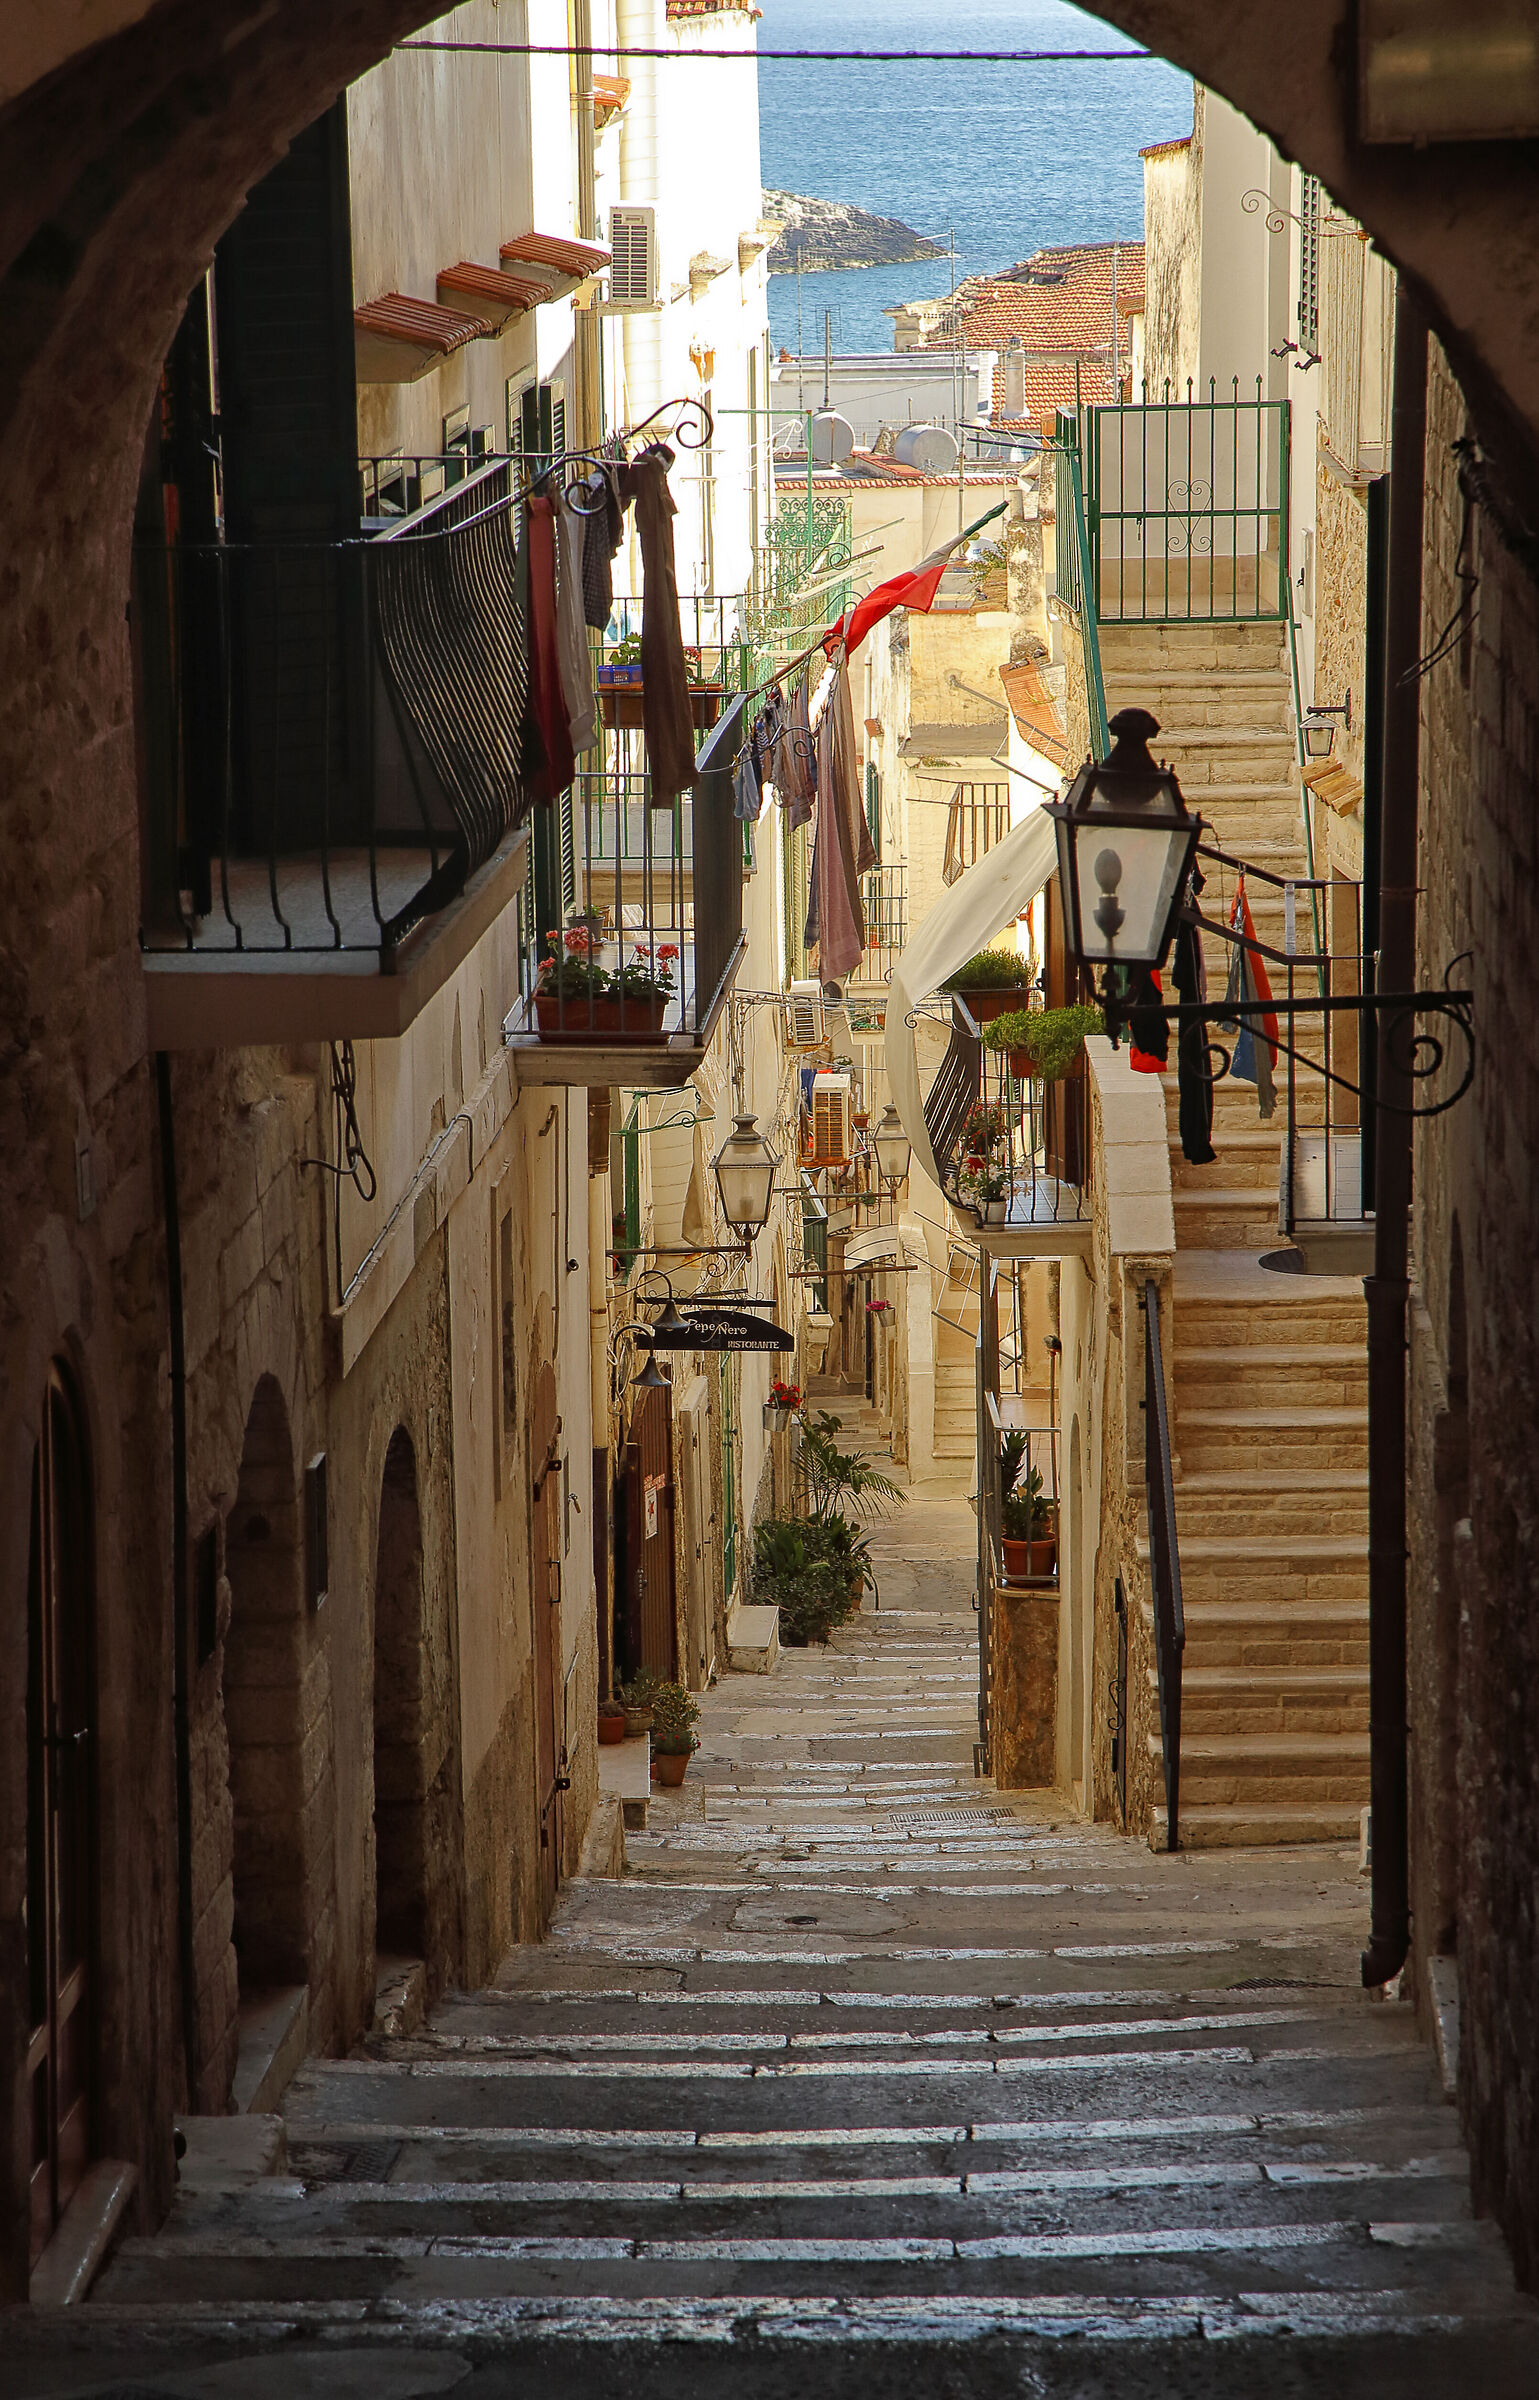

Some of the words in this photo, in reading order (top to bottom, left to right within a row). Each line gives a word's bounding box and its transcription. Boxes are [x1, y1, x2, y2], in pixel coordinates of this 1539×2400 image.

[685, 1319, 716, 1334] Pepe
[701, 1321, 747, 1343] Nero
[727, 1340, 779, 1349] RISTORANTE
